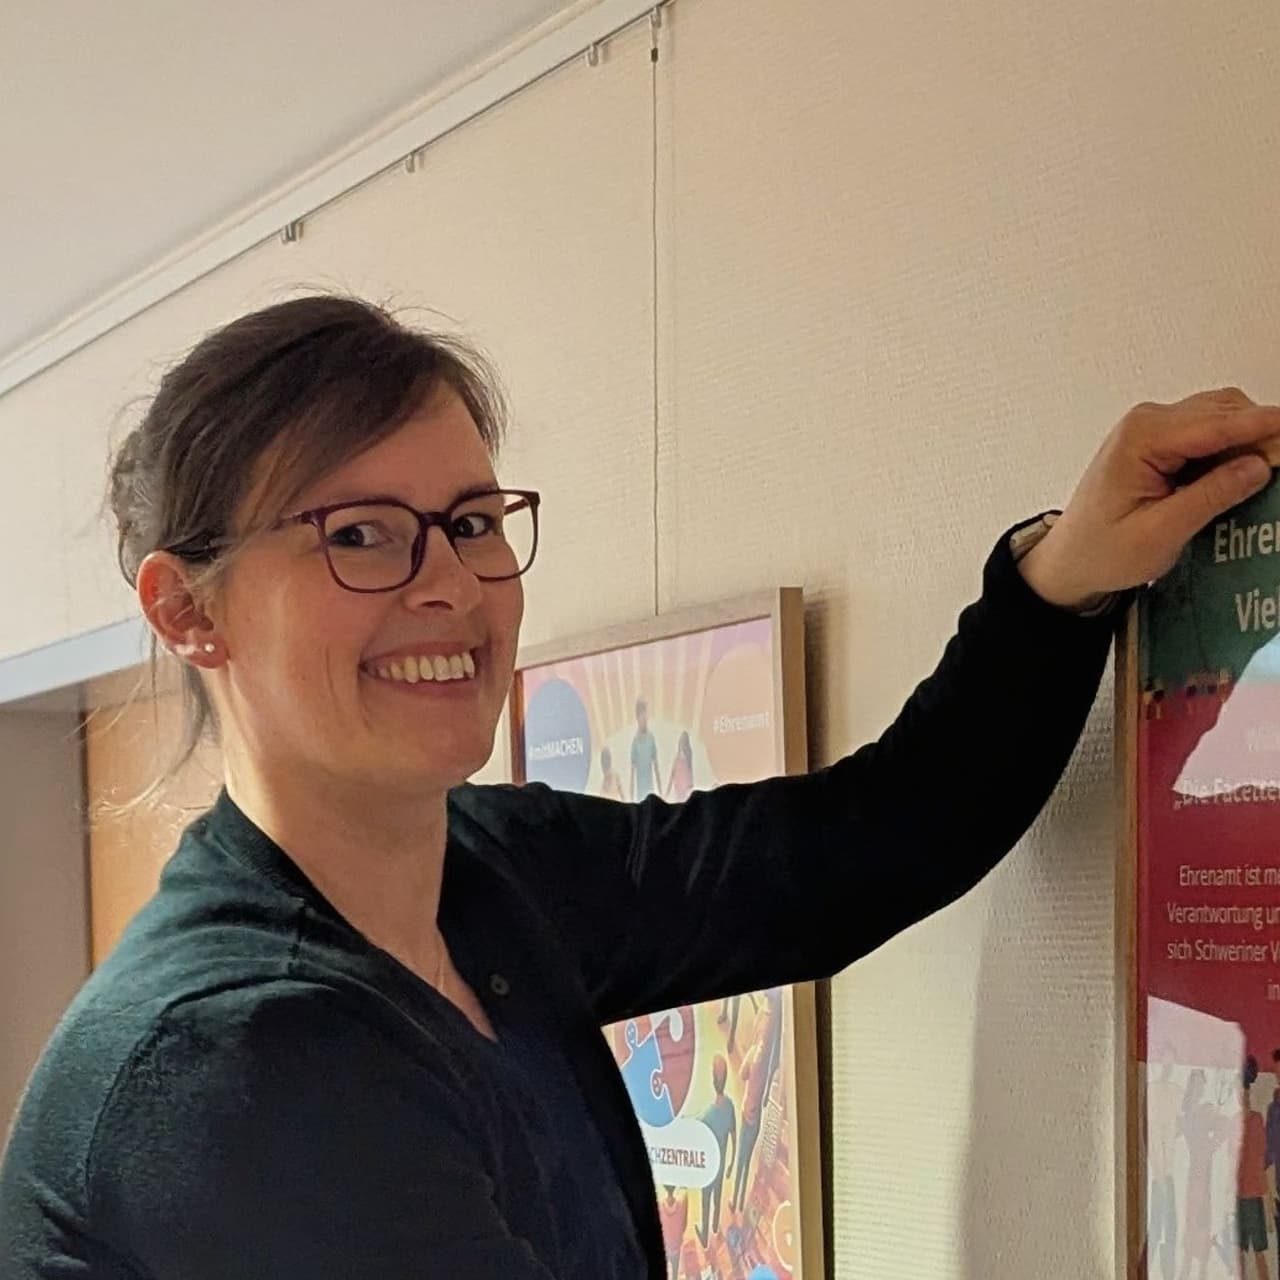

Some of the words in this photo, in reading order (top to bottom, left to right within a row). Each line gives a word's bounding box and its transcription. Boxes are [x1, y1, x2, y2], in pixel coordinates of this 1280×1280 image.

[1179, 864, 1242, 887] Ehrenamt
[1245, 863, 1261, 885] ist
[1167, 902, 1264, 931] Verantwortung
[1167, 938, 1192, 960] sich
[1195, 939, 1268, 962] Schweriner
[1268, 979, 1280, 1001] in
[650, 1146, 706, 1169] CHZENTRALE
